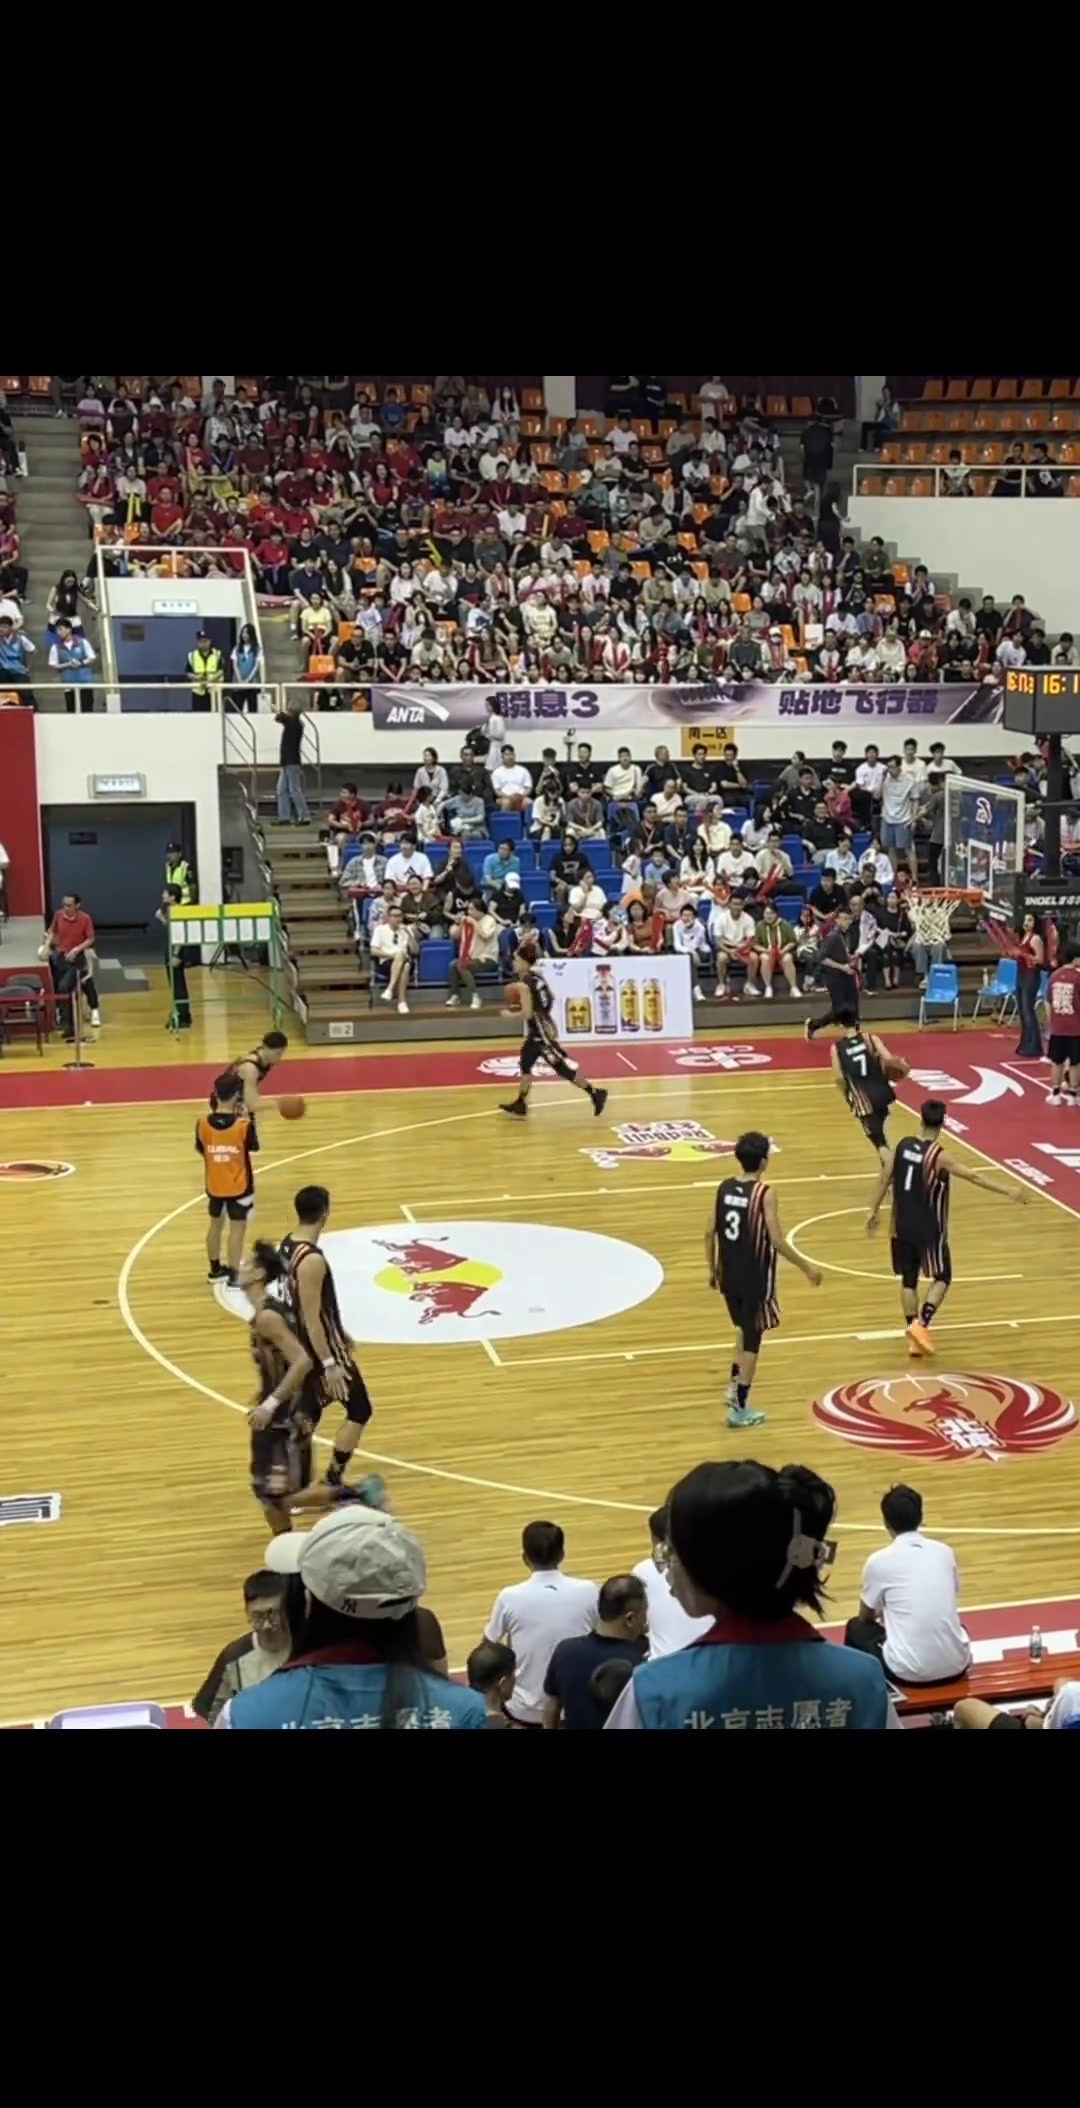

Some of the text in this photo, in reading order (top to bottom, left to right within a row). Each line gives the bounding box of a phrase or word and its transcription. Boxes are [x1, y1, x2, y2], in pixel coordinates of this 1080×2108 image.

[386, 707, 425, 723] ANTA
[778, 689, 939, 716] 贴地飞行器
[852, 1053, 867, 1077] 7
[904, 1165, 914, 1191] 1
[725, 1210, 741, 1241] 3
